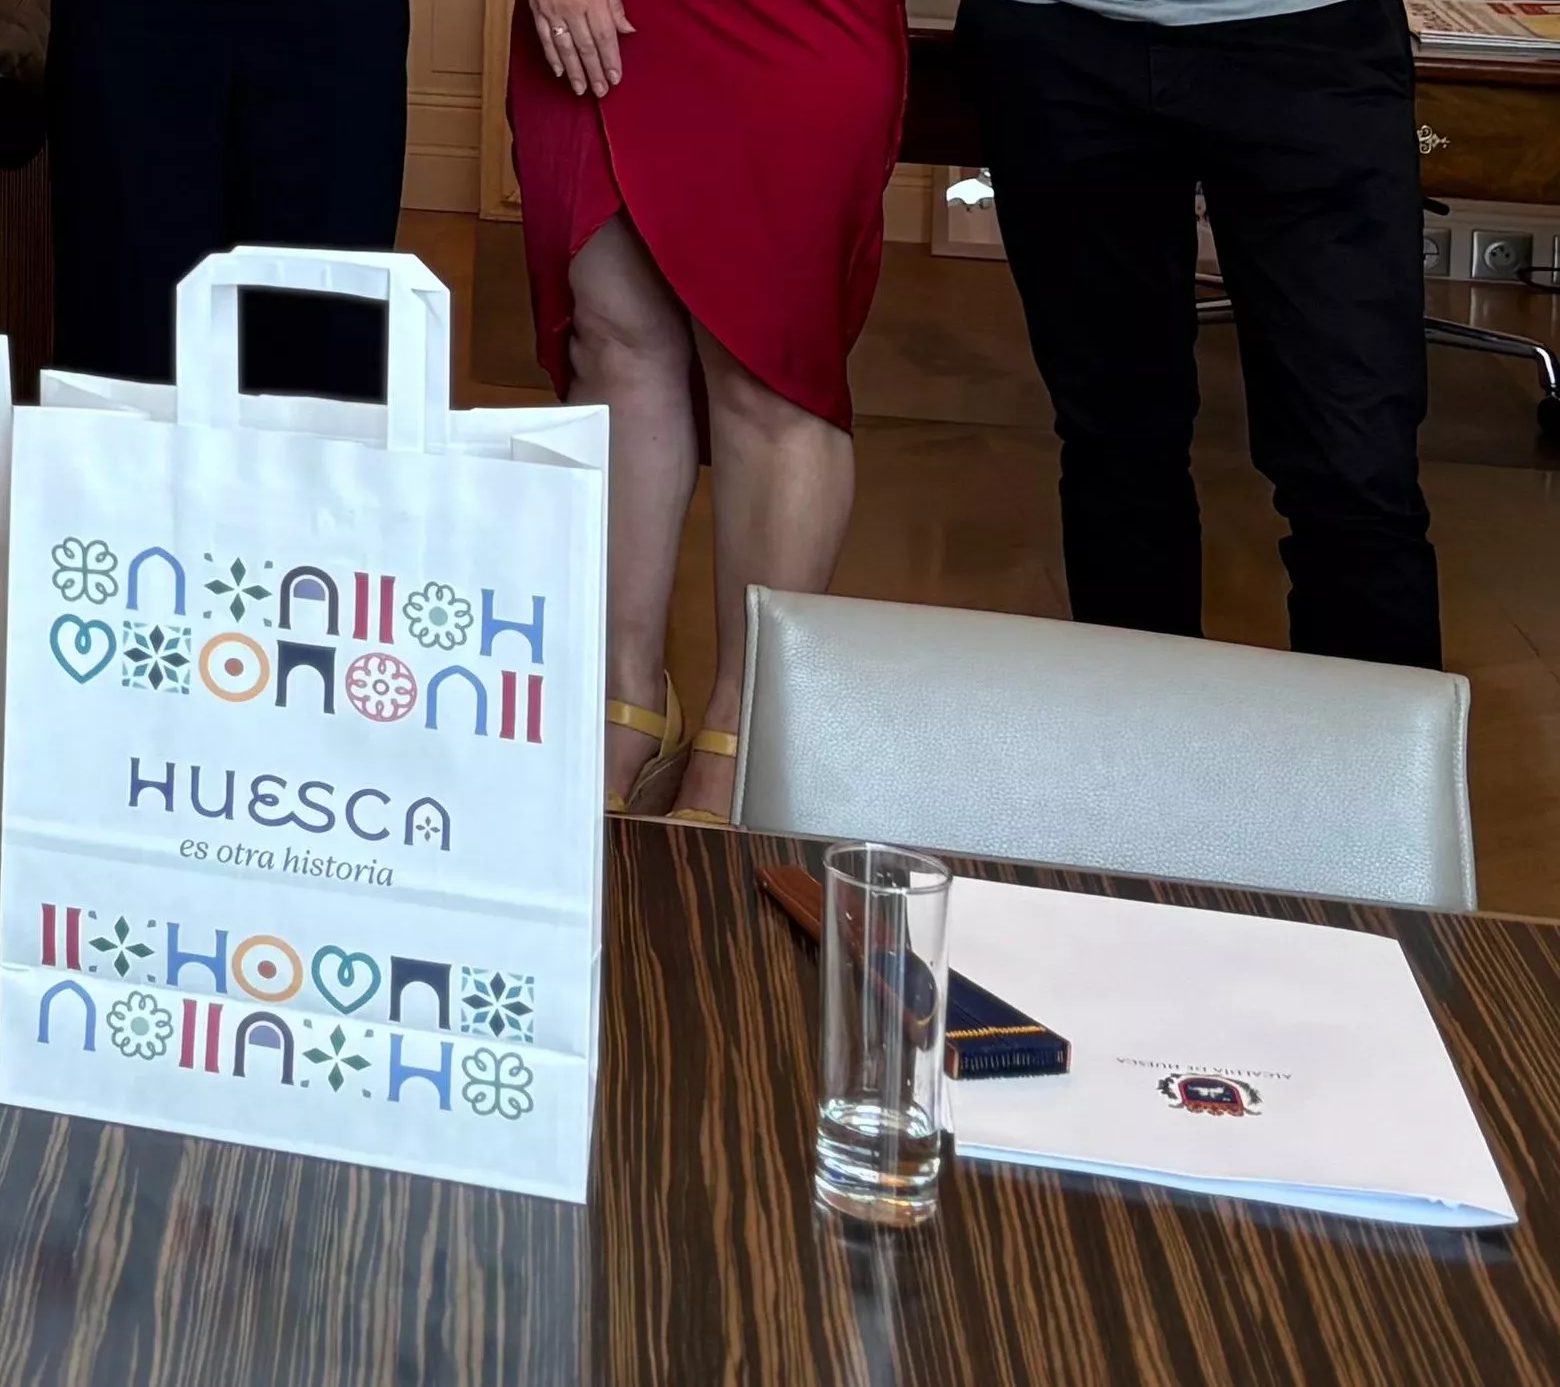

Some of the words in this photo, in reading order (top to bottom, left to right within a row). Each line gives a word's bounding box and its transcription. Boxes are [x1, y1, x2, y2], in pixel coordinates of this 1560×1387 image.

[128, 756, 451, 852] HUESCA
[179, 838, 208, 860] es
[217, 842, 275, 871] otra
[282, 846, 394, 887] historia
